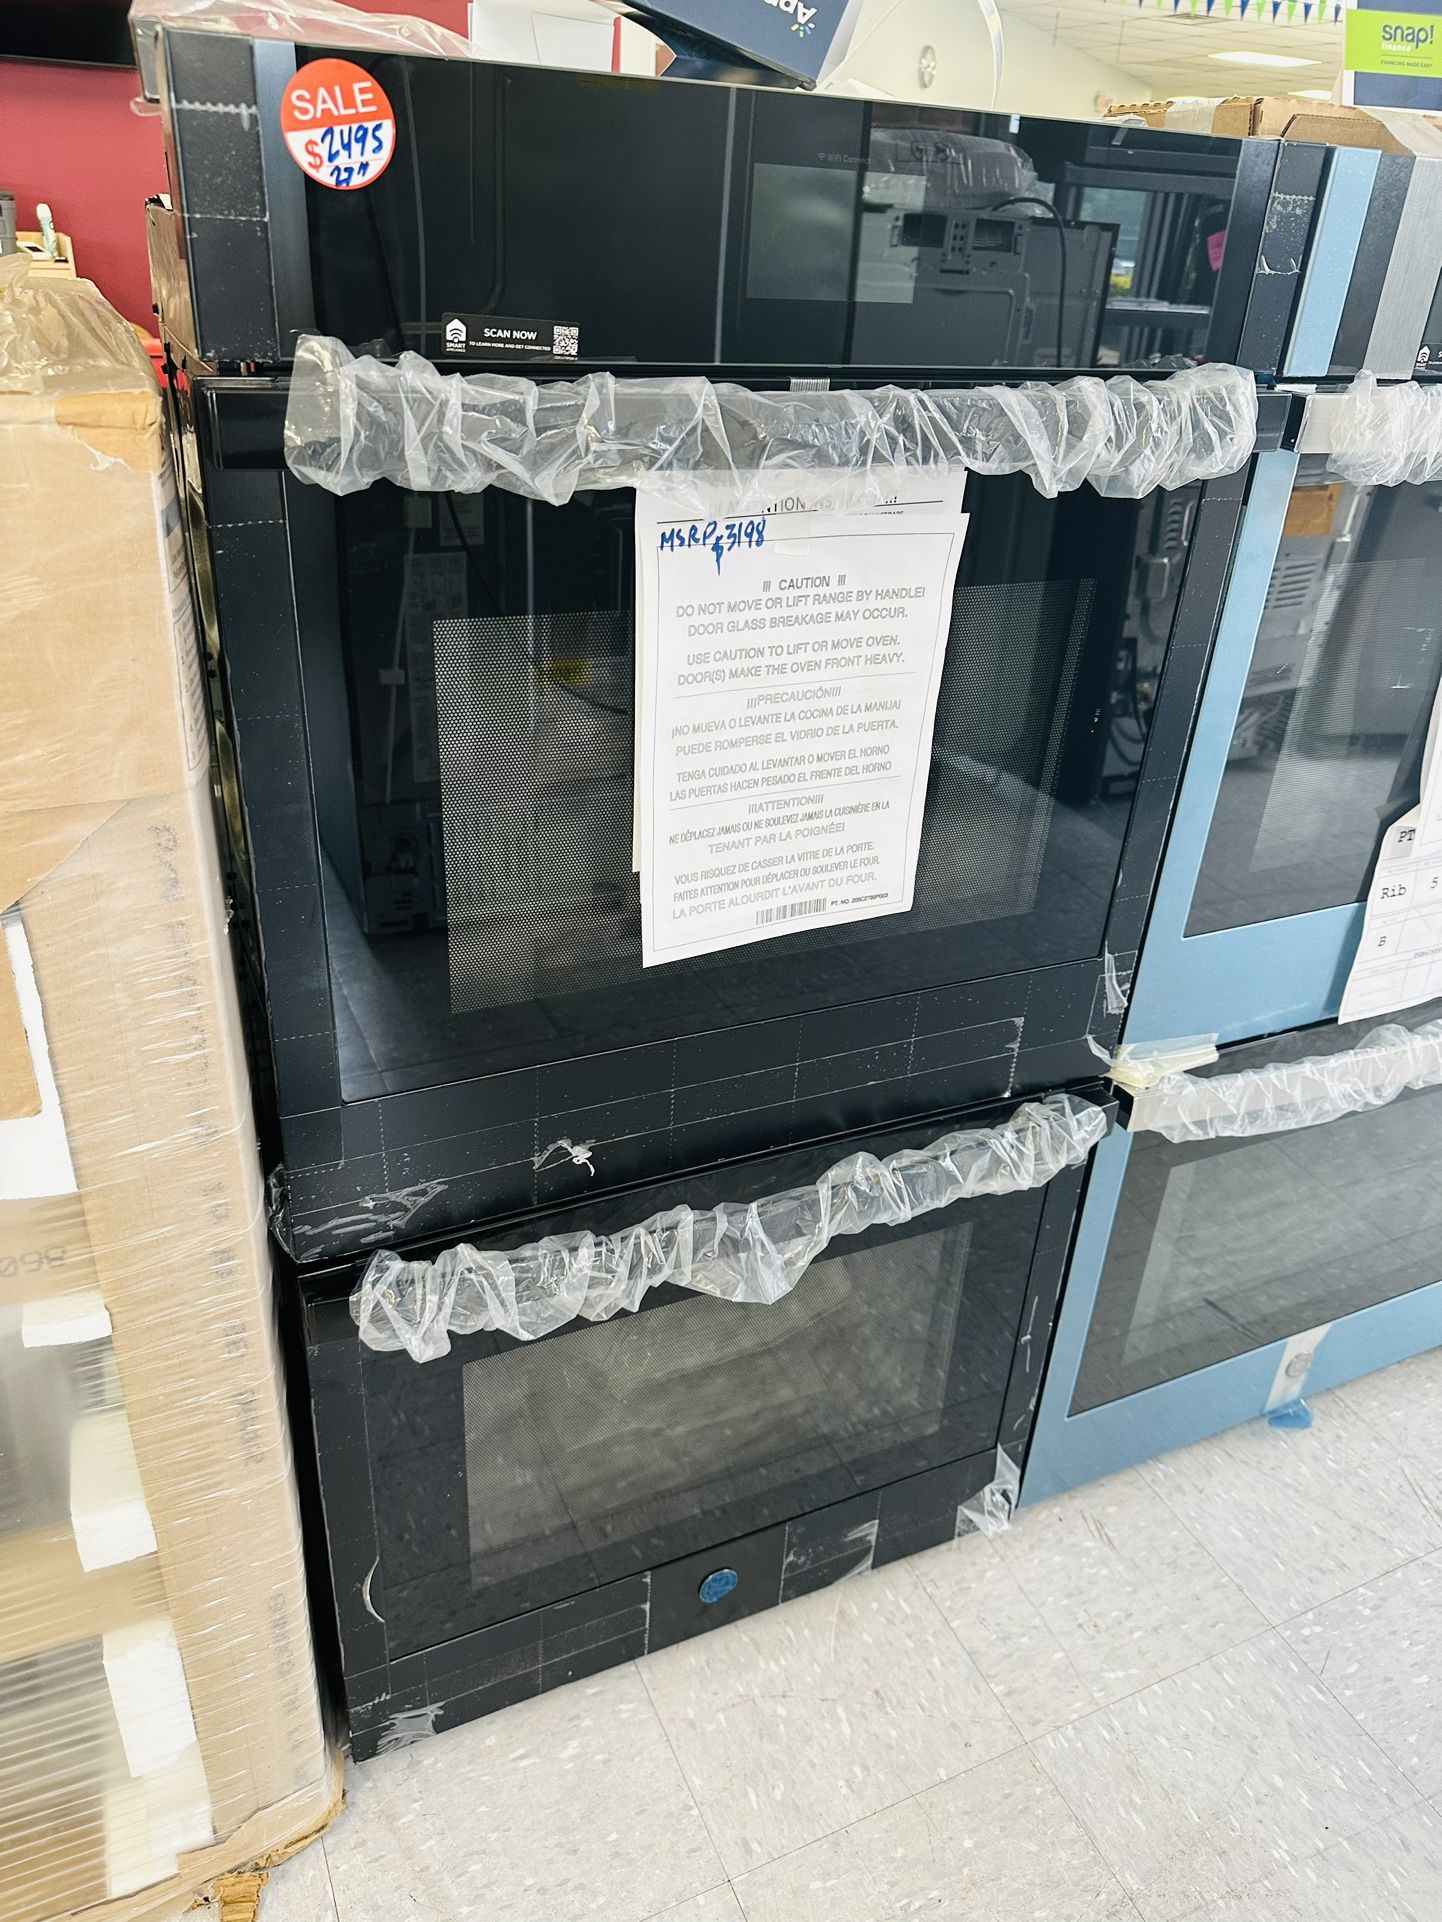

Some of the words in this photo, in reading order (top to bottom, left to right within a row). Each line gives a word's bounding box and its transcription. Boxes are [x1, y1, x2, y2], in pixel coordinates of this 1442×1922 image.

[1382, 24, 1434, 49] snap!
[290, 81, 378, 121] SALE
[483, 328, 511, 339] SCAN
[513, 330, 538, 340] NOW
[660, 520, 718, 552] MSRP
[779, 575, 831, 591] CAUTION
[676, 604, 695, 618] DO
[698, 602, 724, 616] NOT
[727, 598, 762, 613] MOVE
[765, 597, 783, 610] OR
[786, 594, 810, 608] LIFT
[812, 591, 853, 606] RANGE
[856, 589, 873, 602] BY
[875, 586, 925, 601] HANDLE!
[688, 621, 724, 637] DOOR
[727, 617, 767, 633] GLASS
[769, 612, 832, 629] BREAKAGE
[835, 609, 860, 623] MAY
[862, 606, 908, 620] OCCUR.
[687, 652, 711, 666] USE
[713, 646, 765, 663] CAUTION
[768, 644, 784, 657] TO
[787, 642, 810, 656] LIFT
[812, 640, 828, 653] OR
[831, 636, 863, 651] MOVE
[866, 635, 900, 647] OVEN.
[678, 669, 726, 686] DOOR(S)
[728, 665, 762, 680] MAKE
[765, 663, 788, 676] THE
[790, 659, 822, 673] OVEN
[824, 655, 862, 670] FRONT
[865, 652, 905, 665] HEAVY.
[692, 720, 727, 735] MUEVA
[728, 718, 737, 729] O
[739, 712, 782, 728] LEVANTE
[784, 711, 796, 723] LA
[798, 707, 834, 721] COCINA
[836, 704, 849, 716] DE
[850, 703, 862, 714] LA
[864, 699, 901, 712] MANIJA!
[676, 741, 712, 757] PUEDE
[714, 733, 773, 751] ROMPERSE
[774, 731, 788, 743] EL
[790, 727, 824, 741] VIDRIO
[826, 725, 840, 737] DE
[842, 723, 855, 735] LA
[857, 719, 899, 733] PUERTA.
[676, 768, 706, 783] TENGA
[708, 762, 748, 778] CUIDADO
[748, 761, 760, 772] AL
[761, 755, 806, 770] LEVANTAR
[807, 753, 815, 765] O
[816, 750, 846, 764] MOVER
[848, 748, 858, 759] EL
[860, 744, 890, 758] HORNO
[669, 789, 687, 802] LAS
[688, 782, 729, 799] PUERTAS
[730, 778, 759, 792] HACEN
[760, 773, 796, 788] PESADO
[797, 772, 808, 783] EL
[809, 767, 842, 781] FRENTE
[844, 765, 860, 777] DEL
[862, 760, 892, 774] HORNO
[669, 834, 679, 845] NE
[680, 827, 716, 843] DÉPLACEZ
[716, 821, 742, 836] JAMAIS
[742, 820, 753, 831] OU
[754, 819, 764, 830] NE
[764, 813, 799, 828] SOULEVEZ
[799, 809, 824, 823] JAMAIS
[824, 808, 833, 818] LA
[834, 802, 871, 817] CUISINIÈRE
[871, 801, 881, 812] EN
[881, 800, 890, 810] LA
[708, 837, 752, 854] TENANT
[754, 833, 777, 846] PAR
[779, 830, 792, 842] LA
[795, 821, 845, 840] POIGNÉE!
[673, 888, 699, 903] FAITES
[700, 880, 740, 897] ATTENTION
[740, 876, 761, 889] POUR
[762, 869, 799, 885] DÉPLACER
[800, 867, 811, 878] OU
[812, 861, 848, 876] SOULEVER
[849, 858, 859, 869] LE
[859, 855, 880, 868] FOUR.
[674, 871, 699, 885] VOUS
[700, 864, 736, 881] RISQUEZ
[738, 862, 750, 873] DE
[751, 855, 784, 871] CASSER
[785, 854, 796, 865] LA
[797, 849, 821, 862] VITRE
[822, 847, 834, 859] DE
[835, 845, 845, 856] LA
[846, 841, 875, 854] PORTE.
[673, 907, 687, 920] LA
[689, 899, 726, 917] PORTE
[727, 887, 781, 909] ALOURDIT
[782, 879, 826, 896] L'AVANT
[828, 877, 844, 889] DU
[846, 871, 877, 885] FOUR.
[1381, 884, 1407, 900] Rib
[1430, 876, 1440, 889] 5
